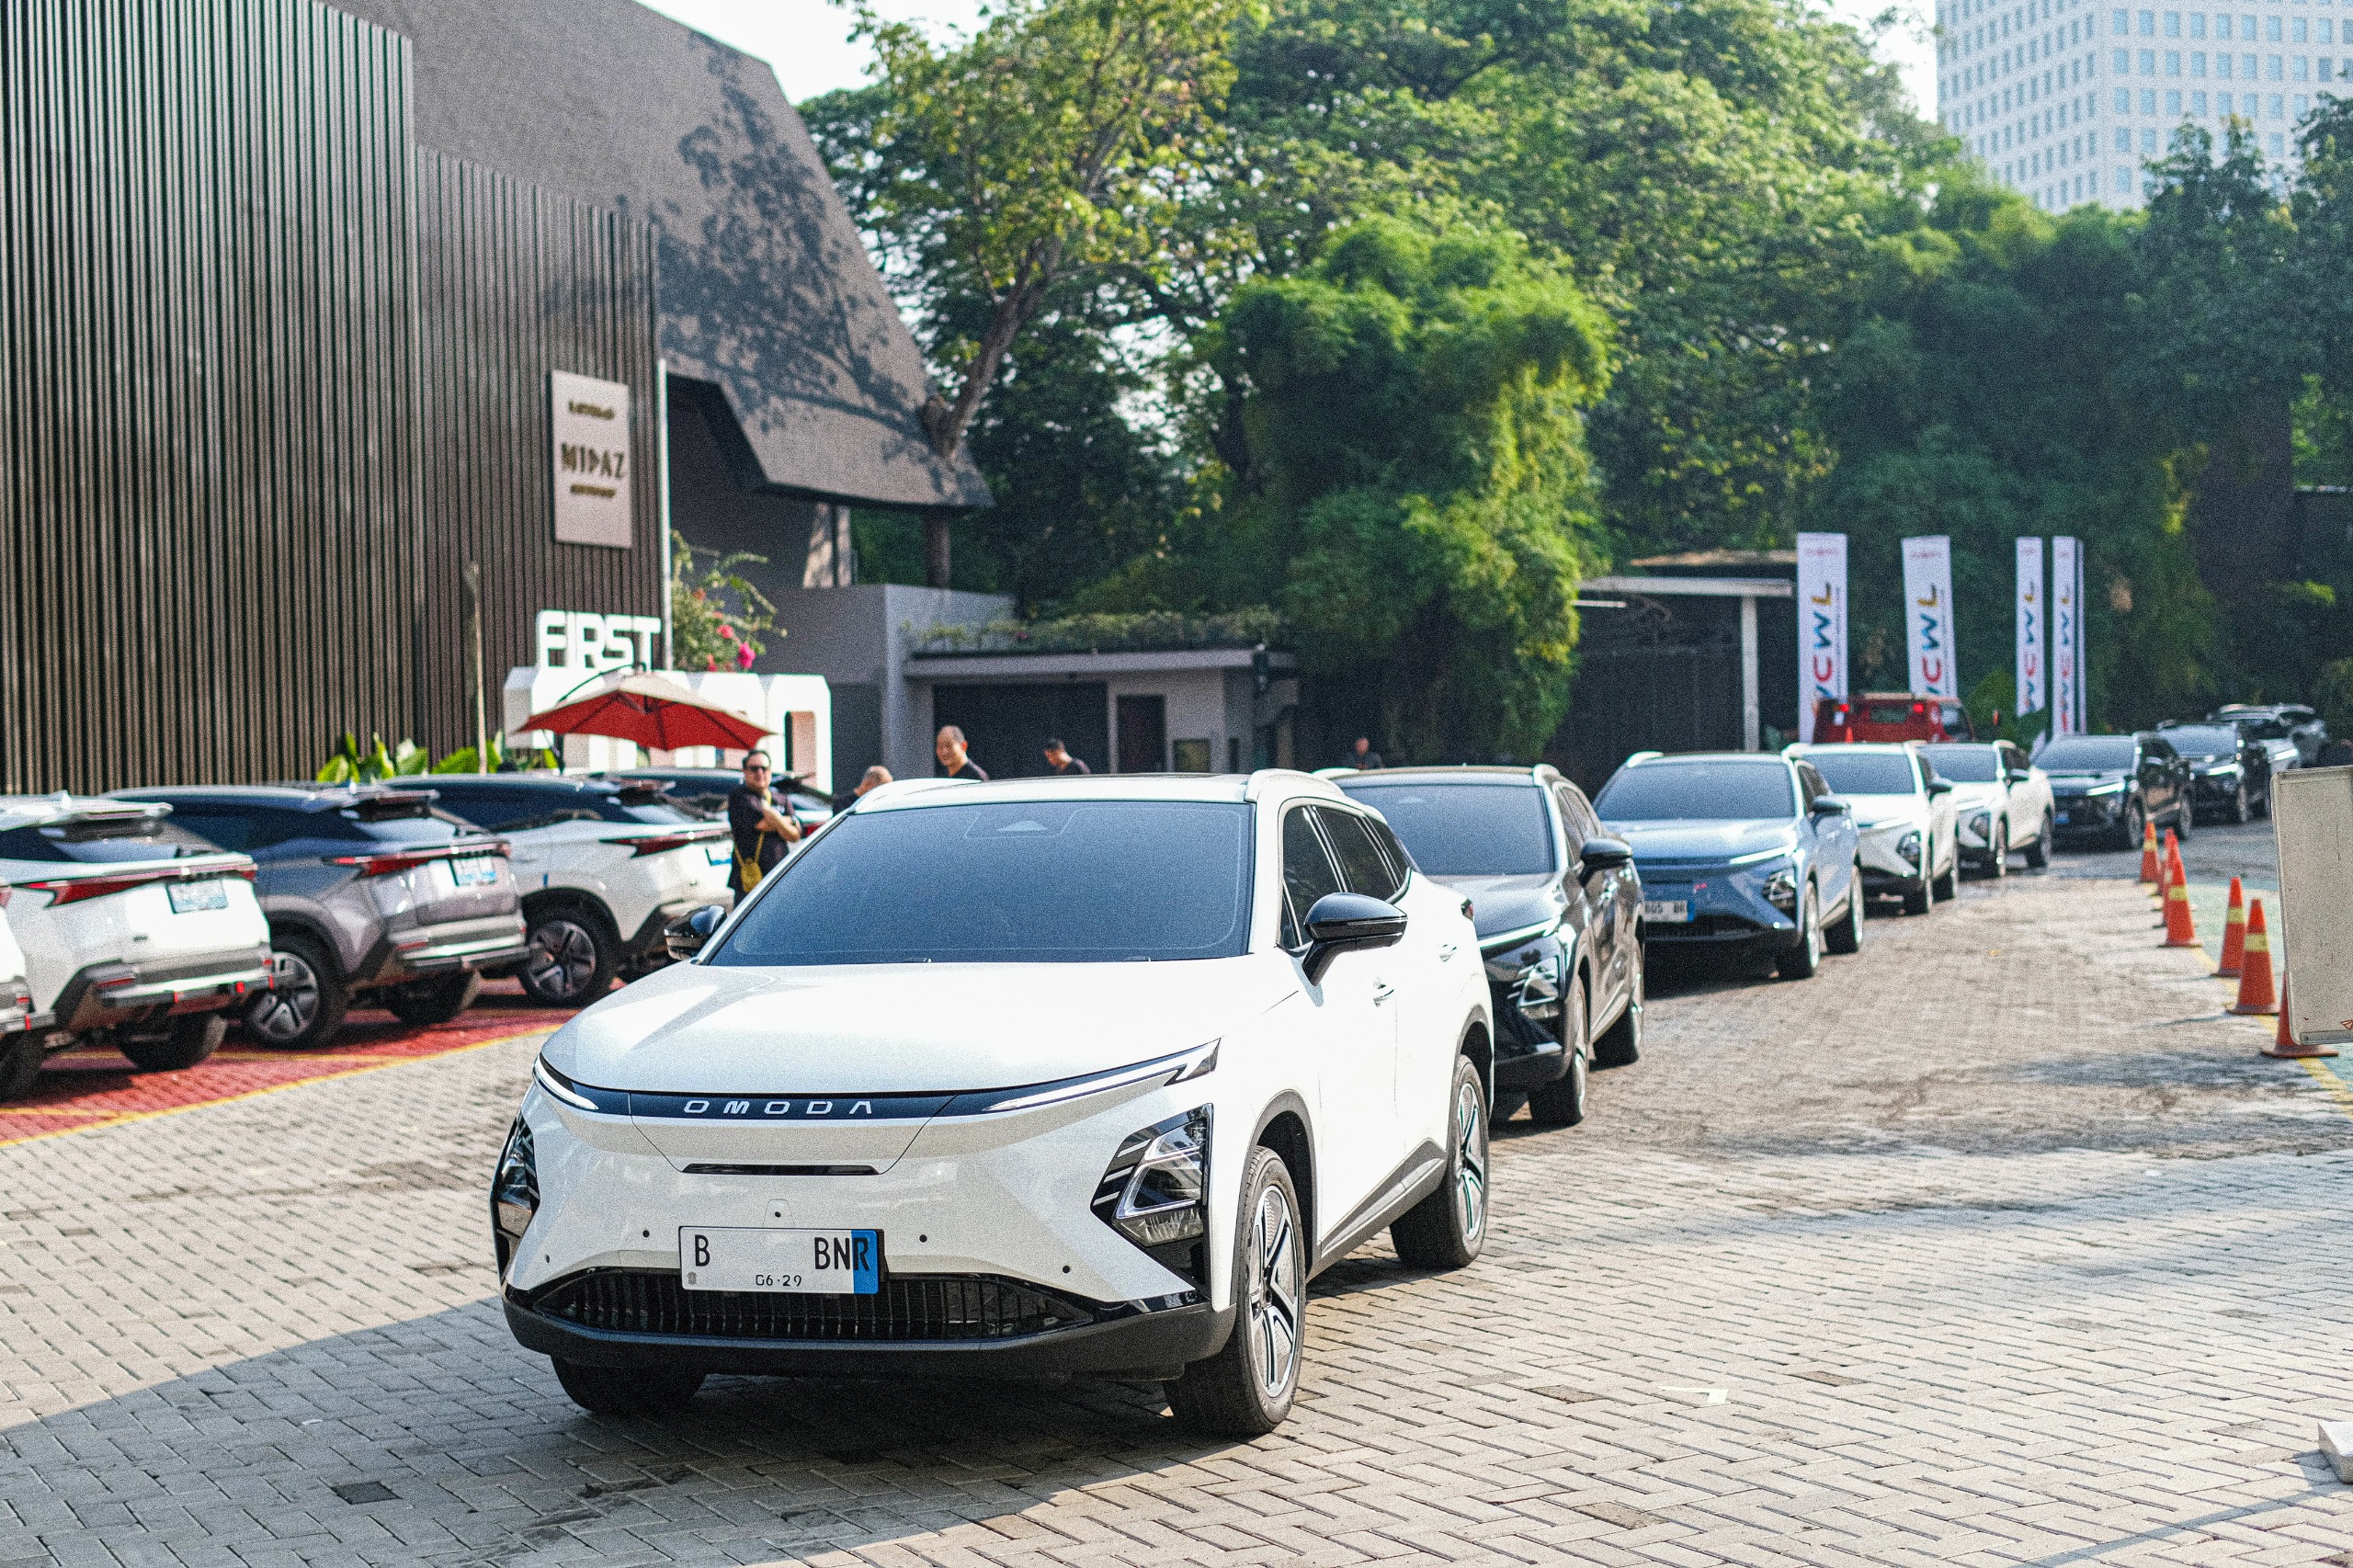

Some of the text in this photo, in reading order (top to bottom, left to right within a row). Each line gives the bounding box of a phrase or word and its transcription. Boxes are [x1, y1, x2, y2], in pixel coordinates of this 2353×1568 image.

[537, 609, 662, 672] FIRST
[1917, 583, 1940, 695] CWL
[683, 1100, 872, 1115] OMODA
[695, 1234, 870, 1270] B BNR
